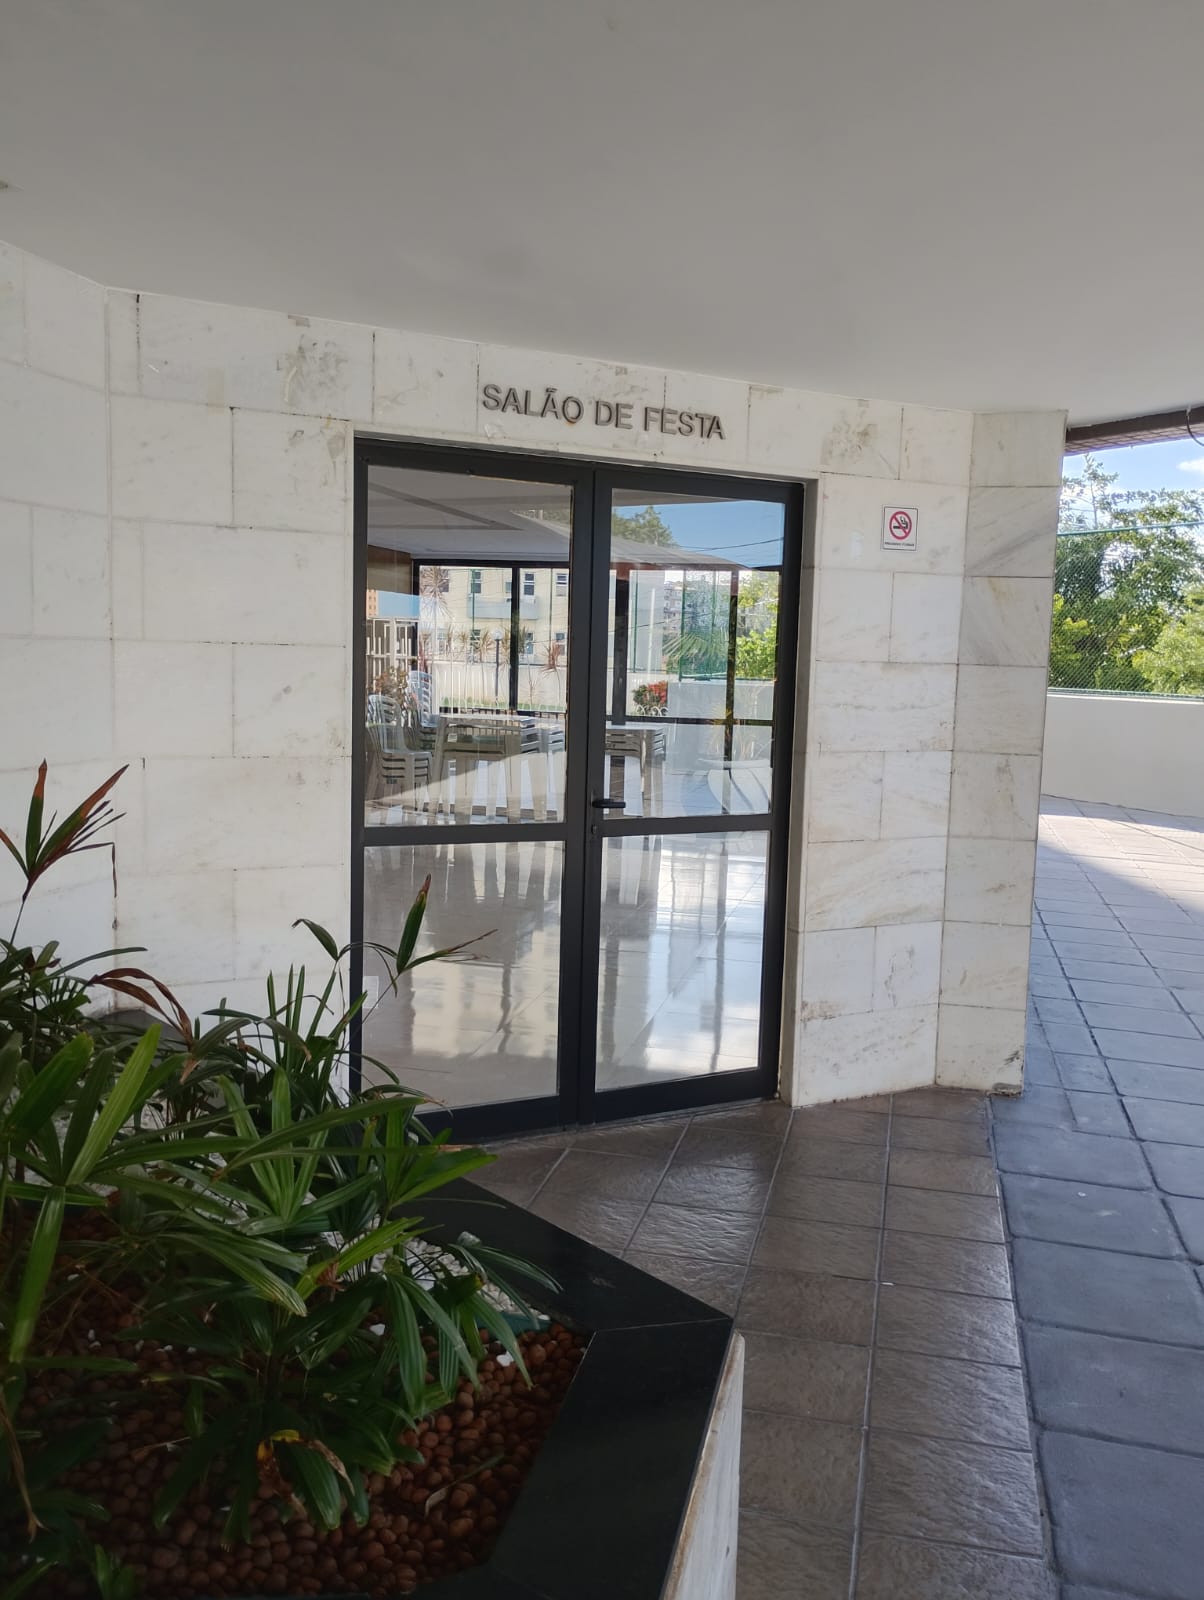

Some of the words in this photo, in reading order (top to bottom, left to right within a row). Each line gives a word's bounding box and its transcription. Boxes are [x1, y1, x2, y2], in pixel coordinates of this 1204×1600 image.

[483, 384, 584, 424] SALÃO
[595, 400, 633, 430] DE
[644, 407, 726, 440] FESTA
